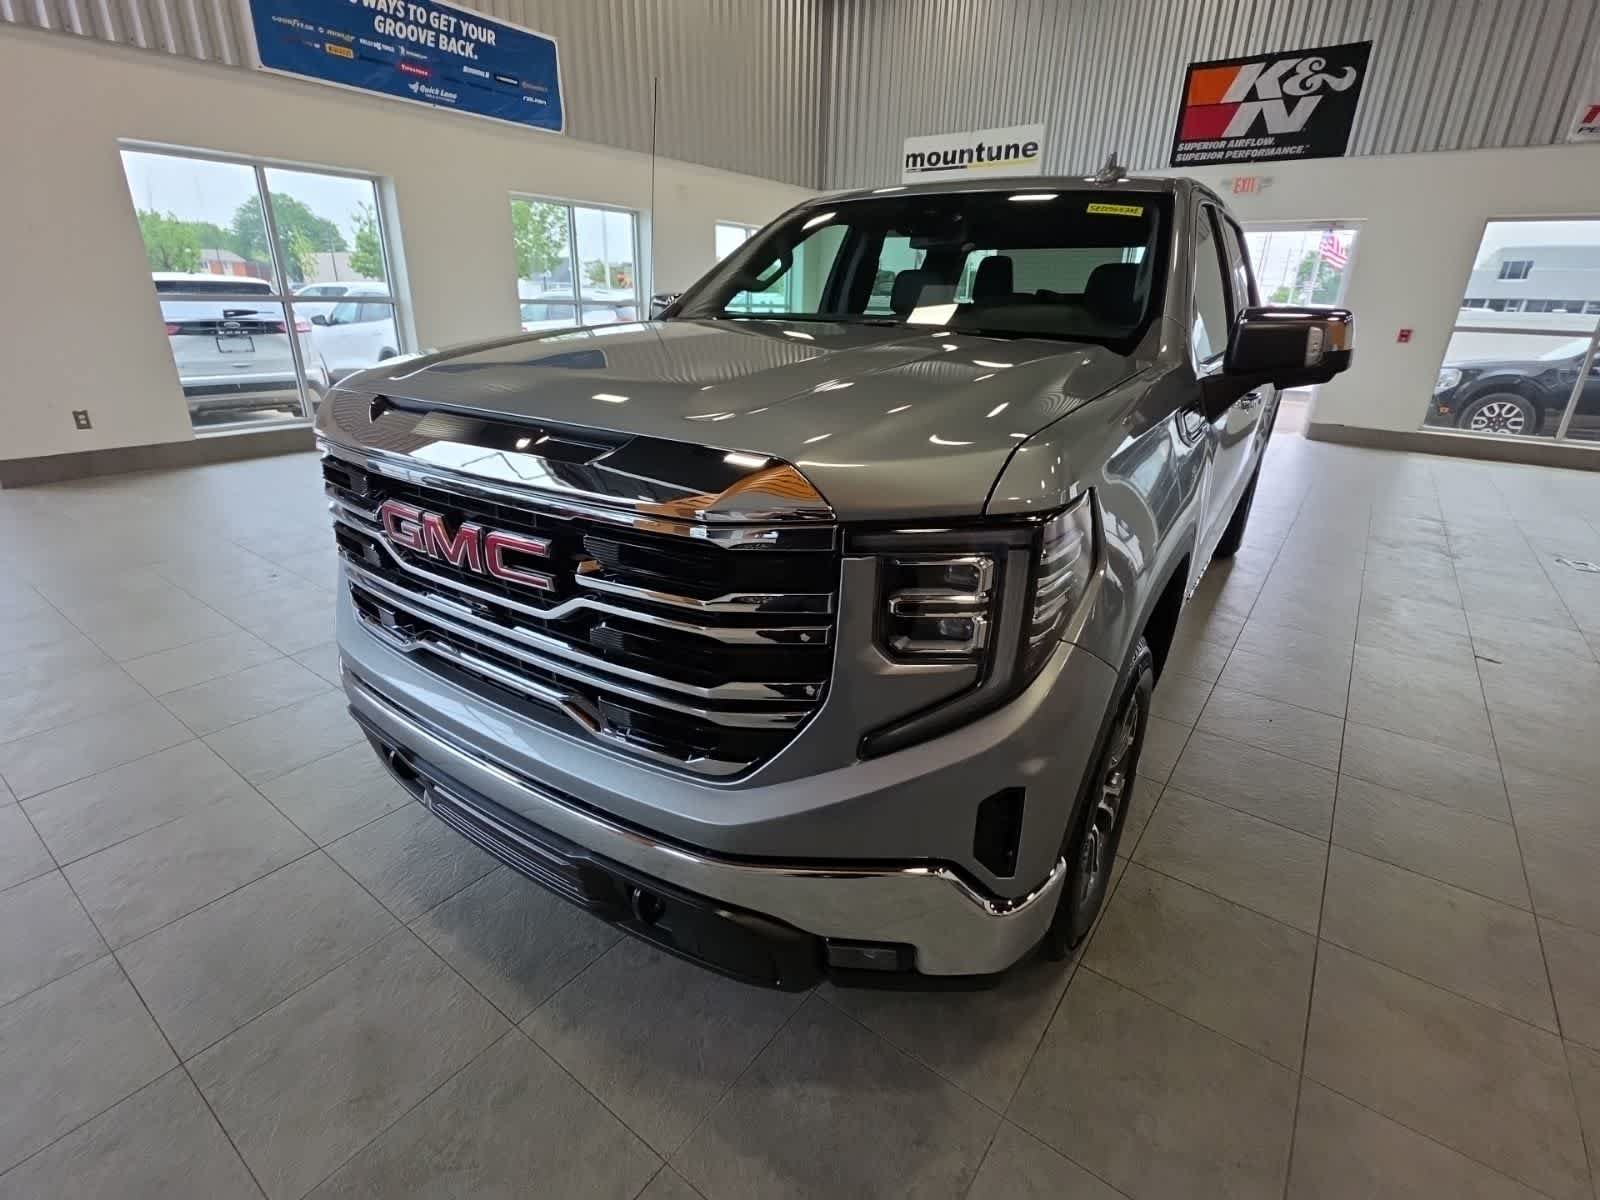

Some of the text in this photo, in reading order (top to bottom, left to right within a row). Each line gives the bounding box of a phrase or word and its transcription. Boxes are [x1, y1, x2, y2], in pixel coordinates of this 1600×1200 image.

[407, 4, 427, 24] TO
[430, 12, 457, 32] GET
[460, 20, 496, 46] YOUR
[374, 15, 436, 47] GROOVE
[439, 34, 479, 60] BACK.
[420, 84, 440, 95] Quick
[440, 89, 458, 99] Lane
[905, 141, 1039, 168] mountune
[1177, 137, 1275, 152] SUPERIOR AIRFLOW.
[1175, 150, 1225, 162] SUPERIOR
[1233, 176, 1257, 194] EXIT
[376, 499, 557, 593] GMC
